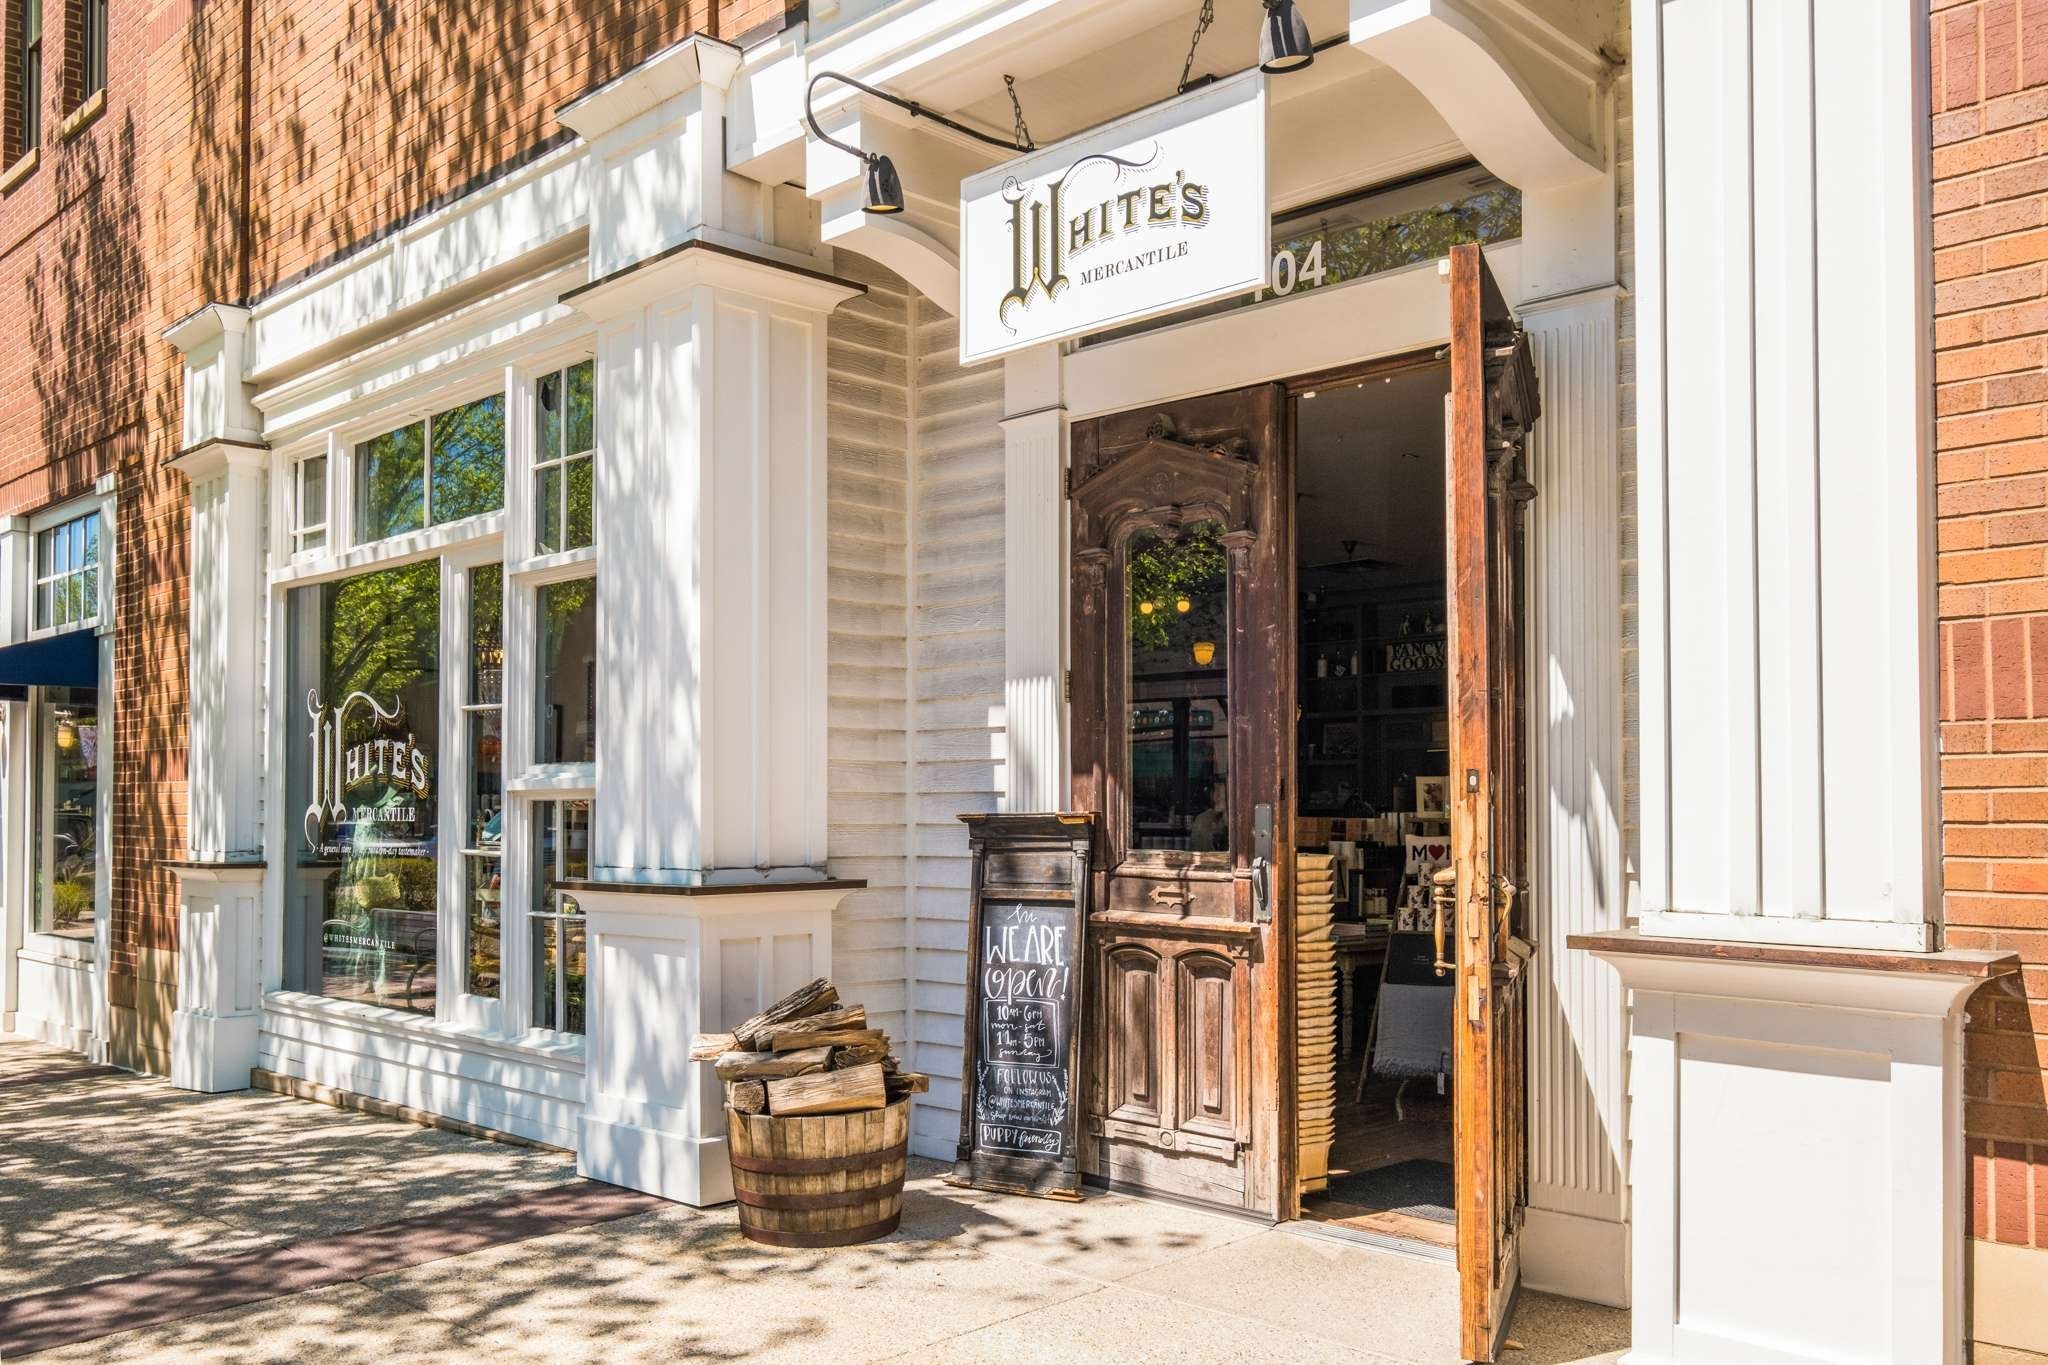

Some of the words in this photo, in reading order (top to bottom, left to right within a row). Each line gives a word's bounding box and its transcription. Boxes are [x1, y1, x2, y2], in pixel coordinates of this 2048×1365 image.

[1080, 241, 1188, 286] MERCANTILE
[1255, 240, 1327, 302] 04
[1391, 641, 1444, 657] FANCY
[1391, 656, 1444, 672] GOODS
[352, 807, 416, 822] MERCANTILE
[323, 932, 396, 950] @WHITESMERCANTILE
[985, 925, 1019, 964] WE
[1024, 925, 1066, 966] ARE
[996, 1068, 1038, 1085] FOLLOW
[1039, 1071, 1053, 1084] US
[1003, 1086, 1013, 1095] ON
[1016, 1088, 1052, 1097] INSTAGRAM
[988, 1095, 1056, 1110] @WHITESMERCANTILE
[983, 1125, 1019, 1144] PUPPY
